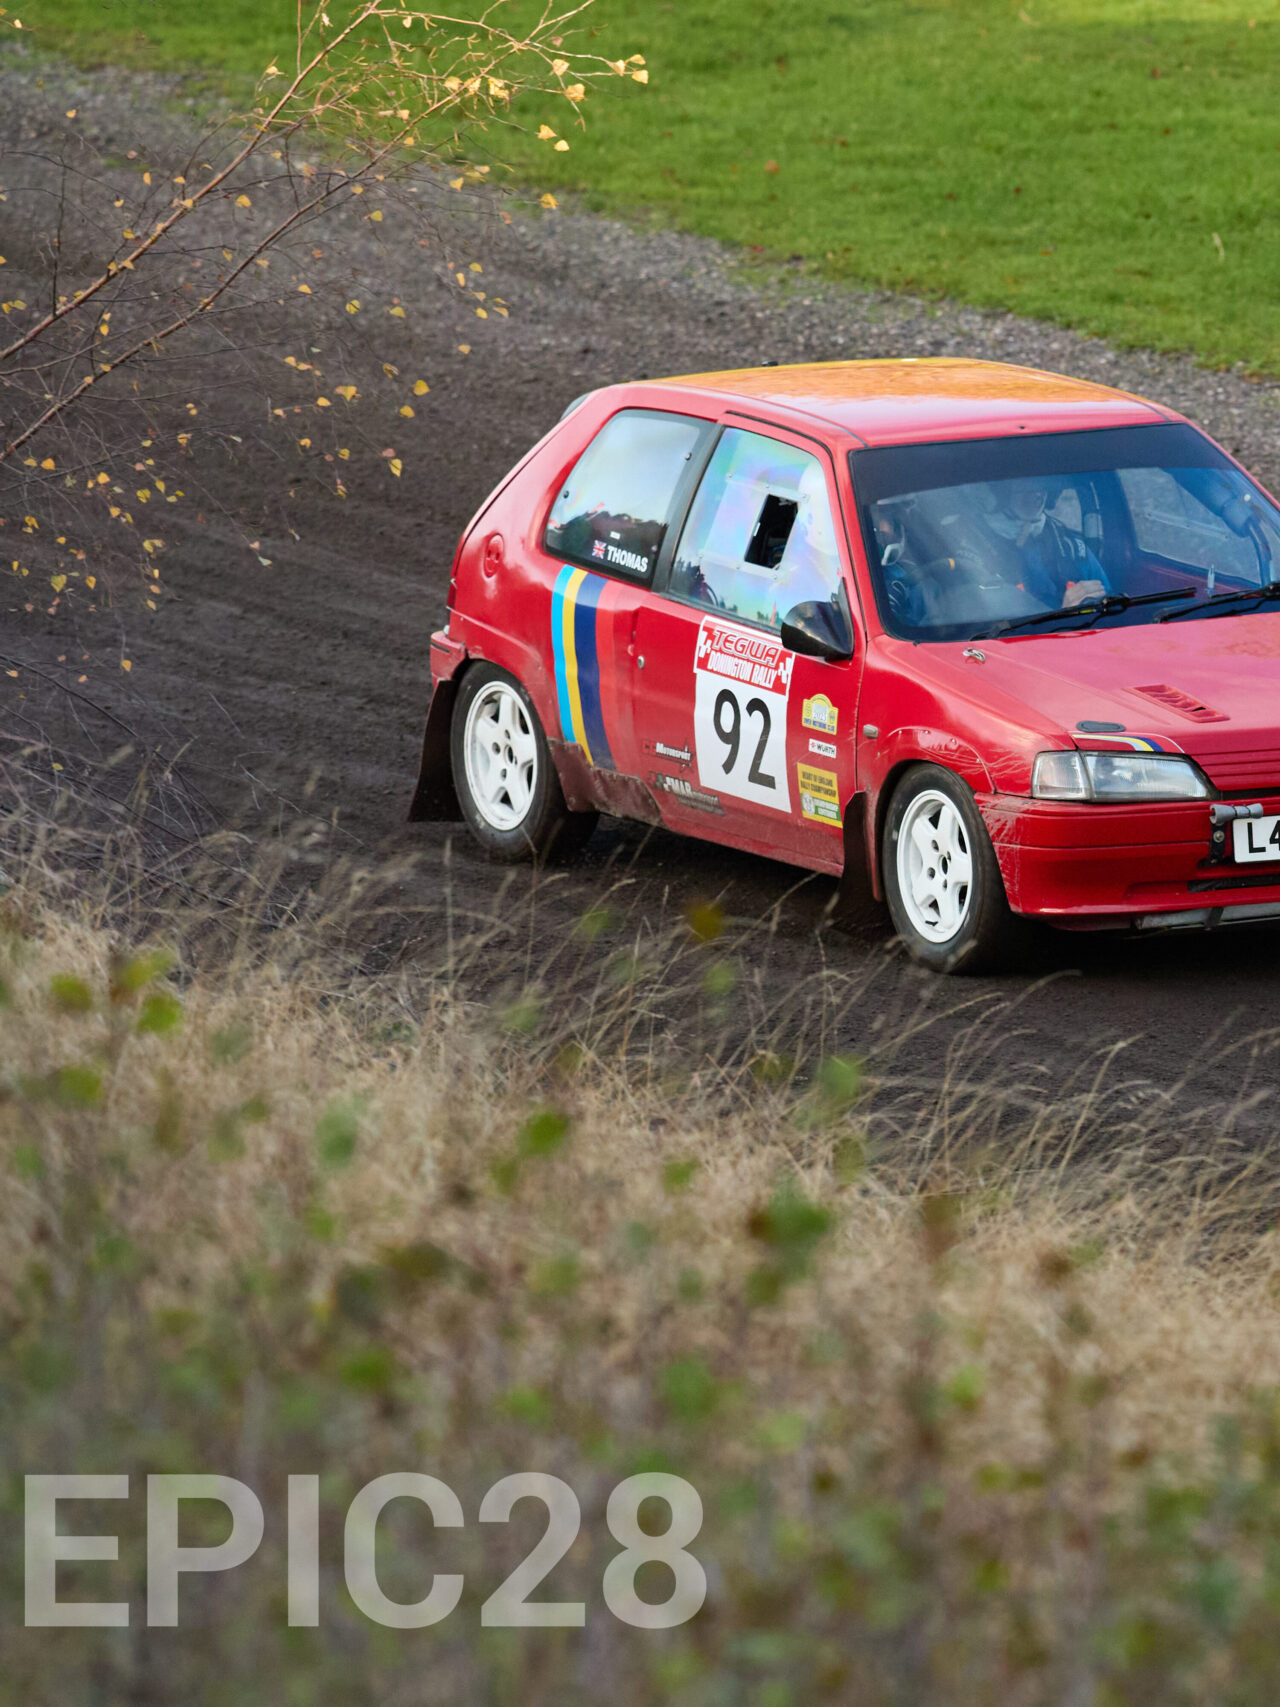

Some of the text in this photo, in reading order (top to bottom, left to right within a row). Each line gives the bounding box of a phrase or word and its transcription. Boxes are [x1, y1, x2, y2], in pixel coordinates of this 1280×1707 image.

[607, 545, 649, 573] THOMAS
[712, 628, 781, 668] TEGIWA
[707, 650, 778, 689] DONINGTON RALLY
[713, 689, 776, 790] 92
